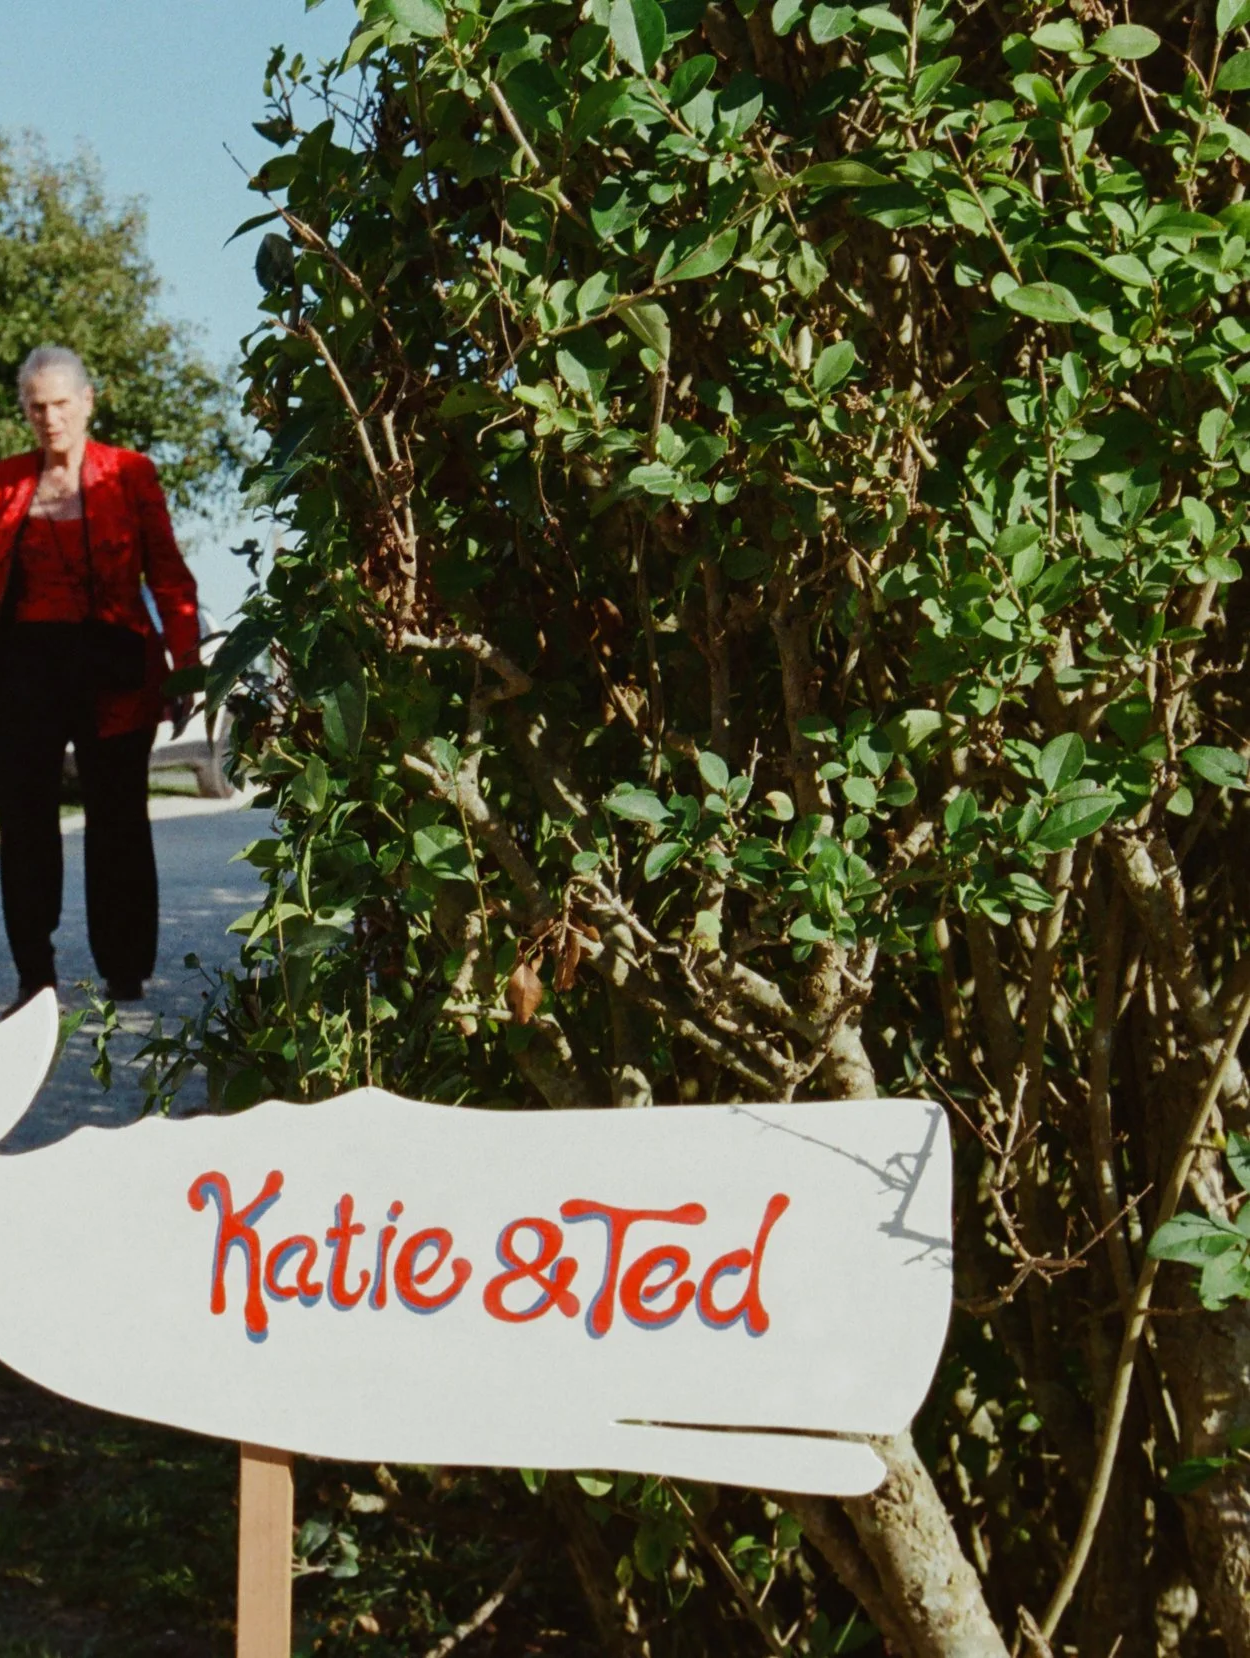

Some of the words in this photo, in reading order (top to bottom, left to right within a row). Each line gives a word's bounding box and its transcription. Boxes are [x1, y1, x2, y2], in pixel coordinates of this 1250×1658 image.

[187, 1170, 472, 1343] Katie
[483, 1217, 581, 1324] &
[560, 1192, 791, 1339] Ted
